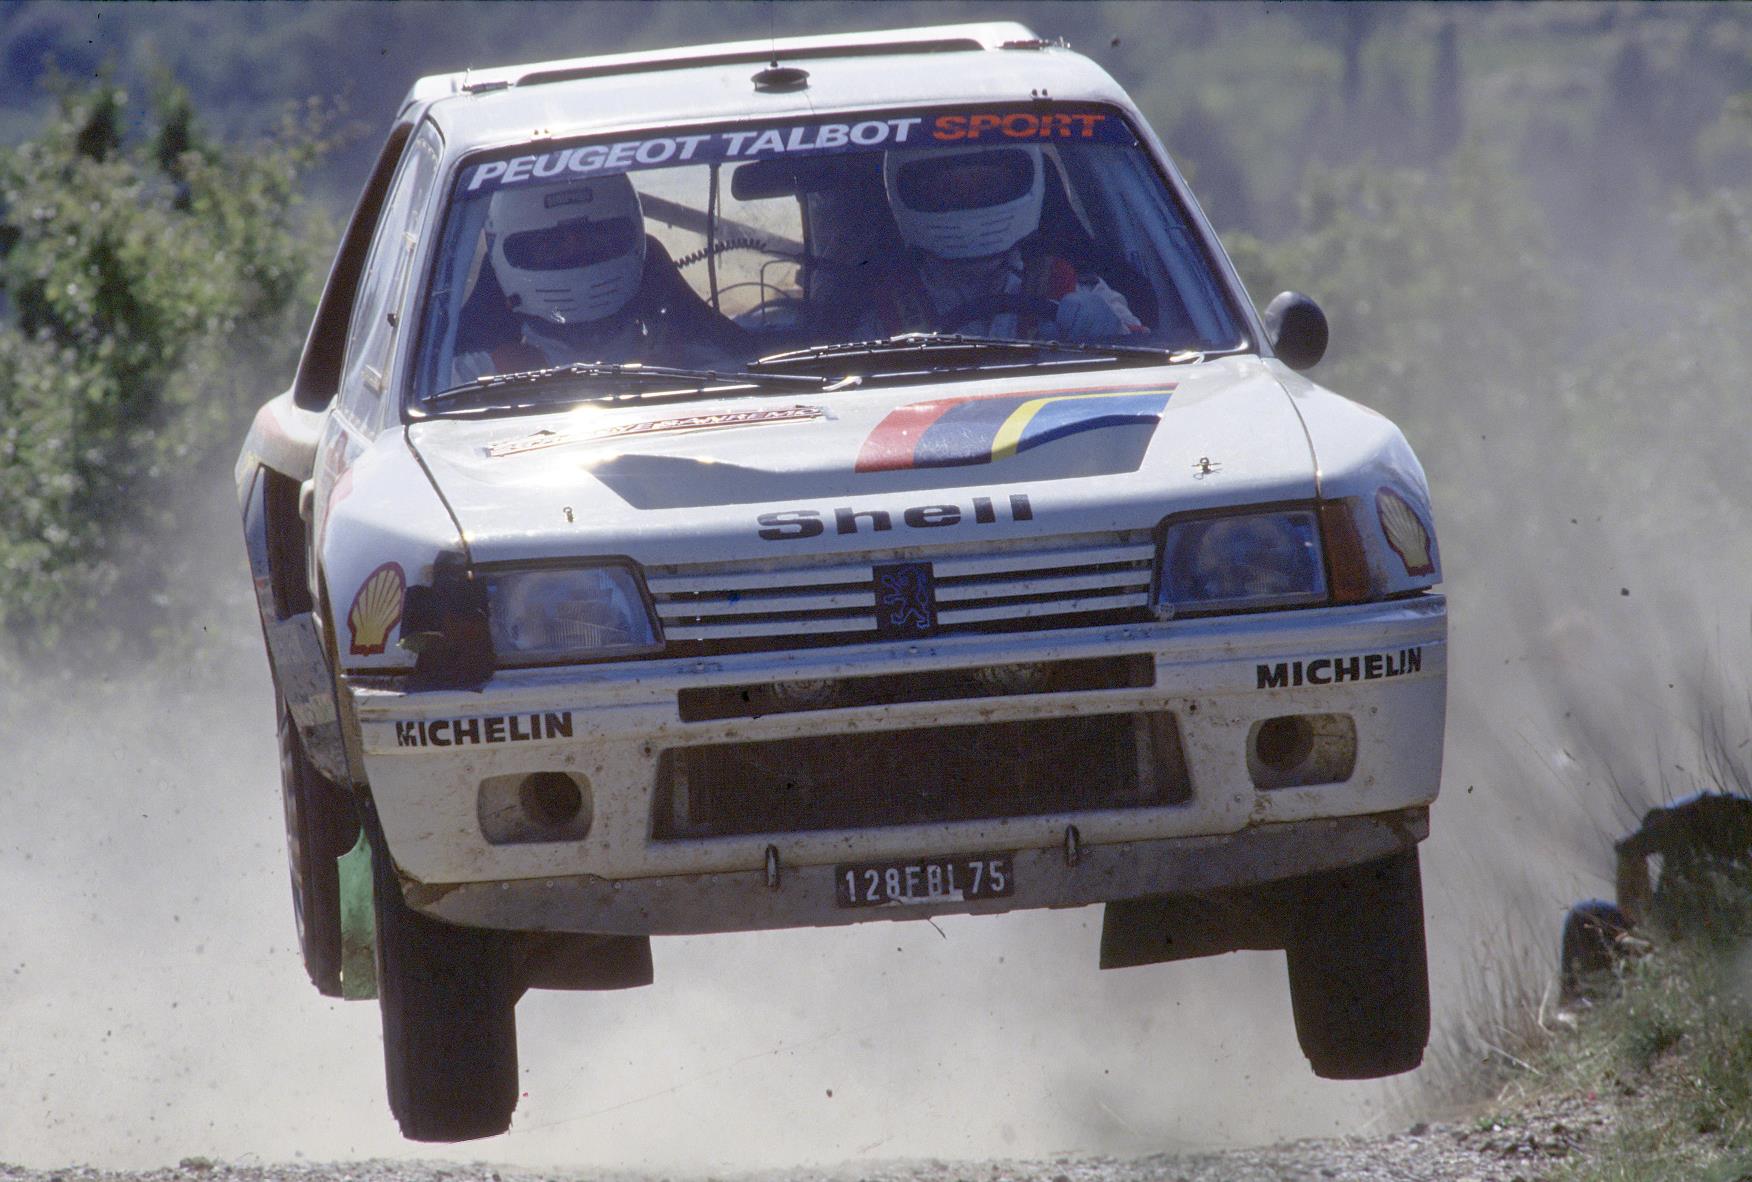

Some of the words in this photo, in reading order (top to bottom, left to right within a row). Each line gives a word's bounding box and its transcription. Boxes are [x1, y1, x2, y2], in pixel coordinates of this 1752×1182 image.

[467, 135, 710, 190] PEUGEOT
[724, 117, 921, 156] TALBOT
[932, 113, 1105, 140] SPORT
[757, 494, 1033, 540] Shell
[1256, 646, 1422, 689] MICHELIN
[395, 711, 573, 747] MICHELIN
